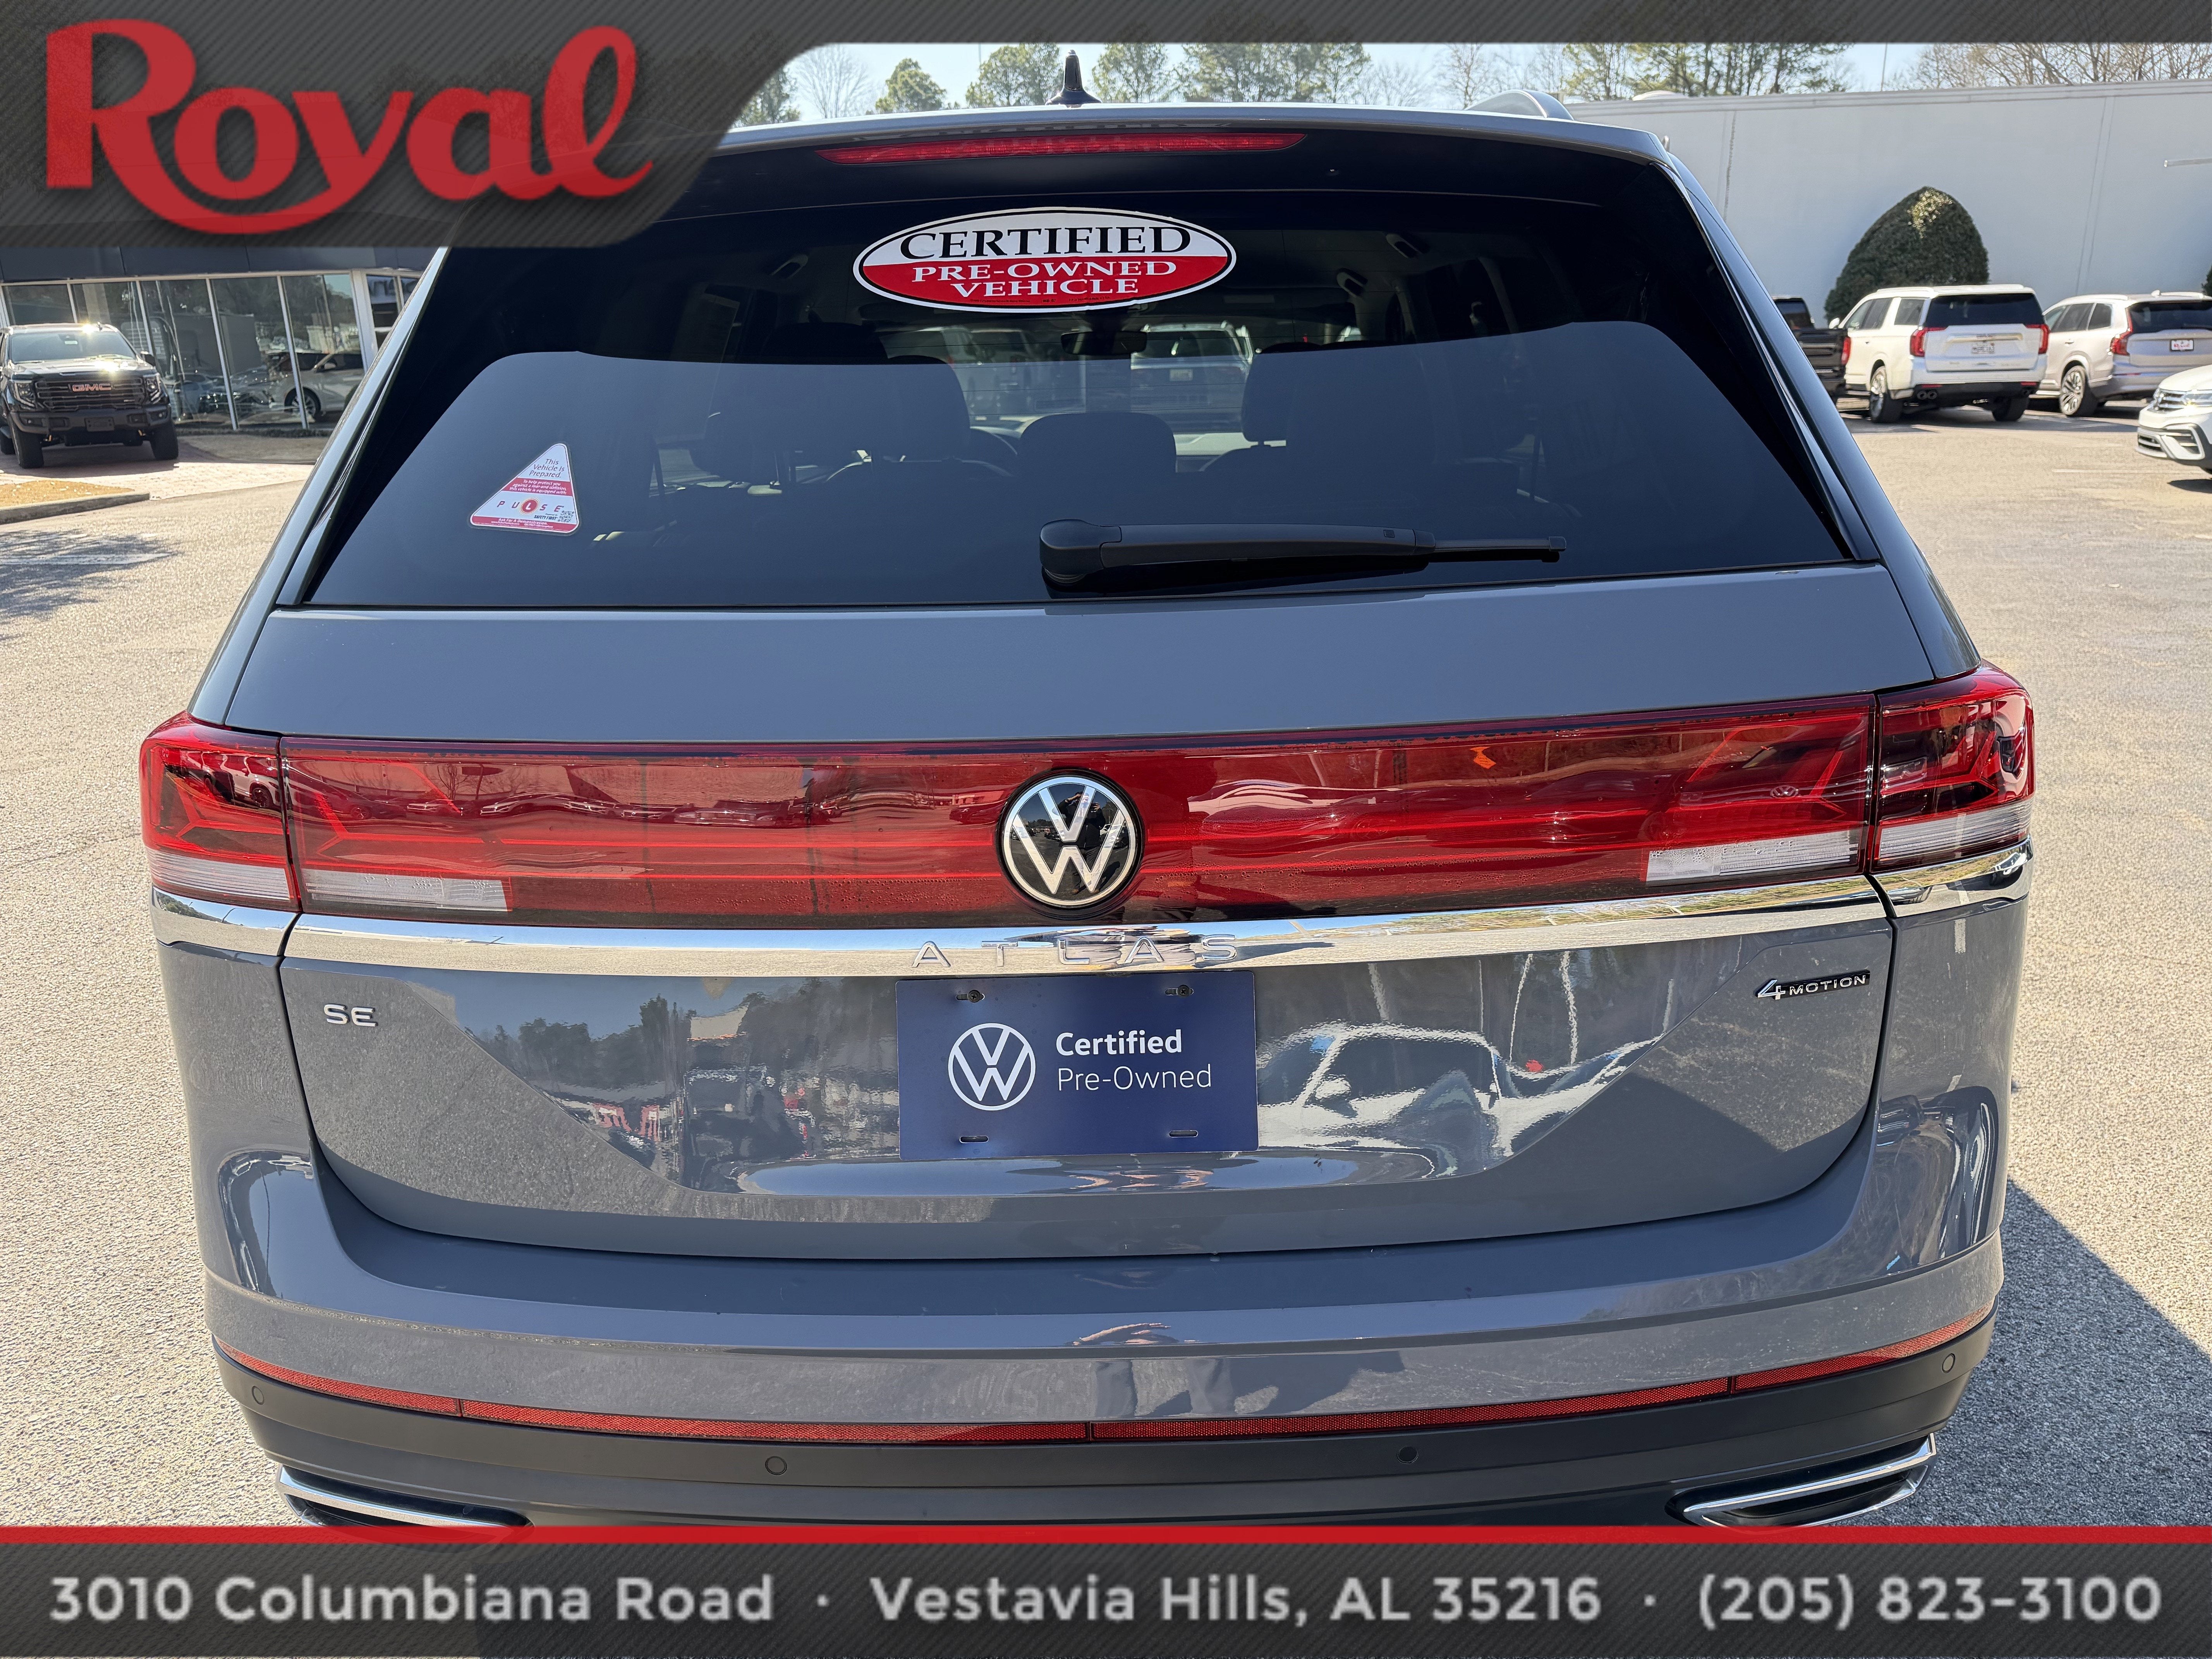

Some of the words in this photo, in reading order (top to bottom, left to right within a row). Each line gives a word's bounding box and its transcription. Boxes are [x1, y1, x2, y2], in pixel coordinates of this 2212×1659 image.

[900, 227, 1190, 259] CERTIFIED
[912, 261, 1176, 282] PRE-OWNED
[950, 279, 1138, 297] VEHICLE
[72, 383, 112, 392] GMC
[496, 500, 564, 512] PULSE
[912, 934, 1237, 968] ATLAS
[1757, 975, 1867, 1000] 4MOTION
[324, 1004, 378, 1027] SE
[1056, 1029, 1182, 1056] Certified
[1058, 1063, 1211, 1091] Pre-Owned
